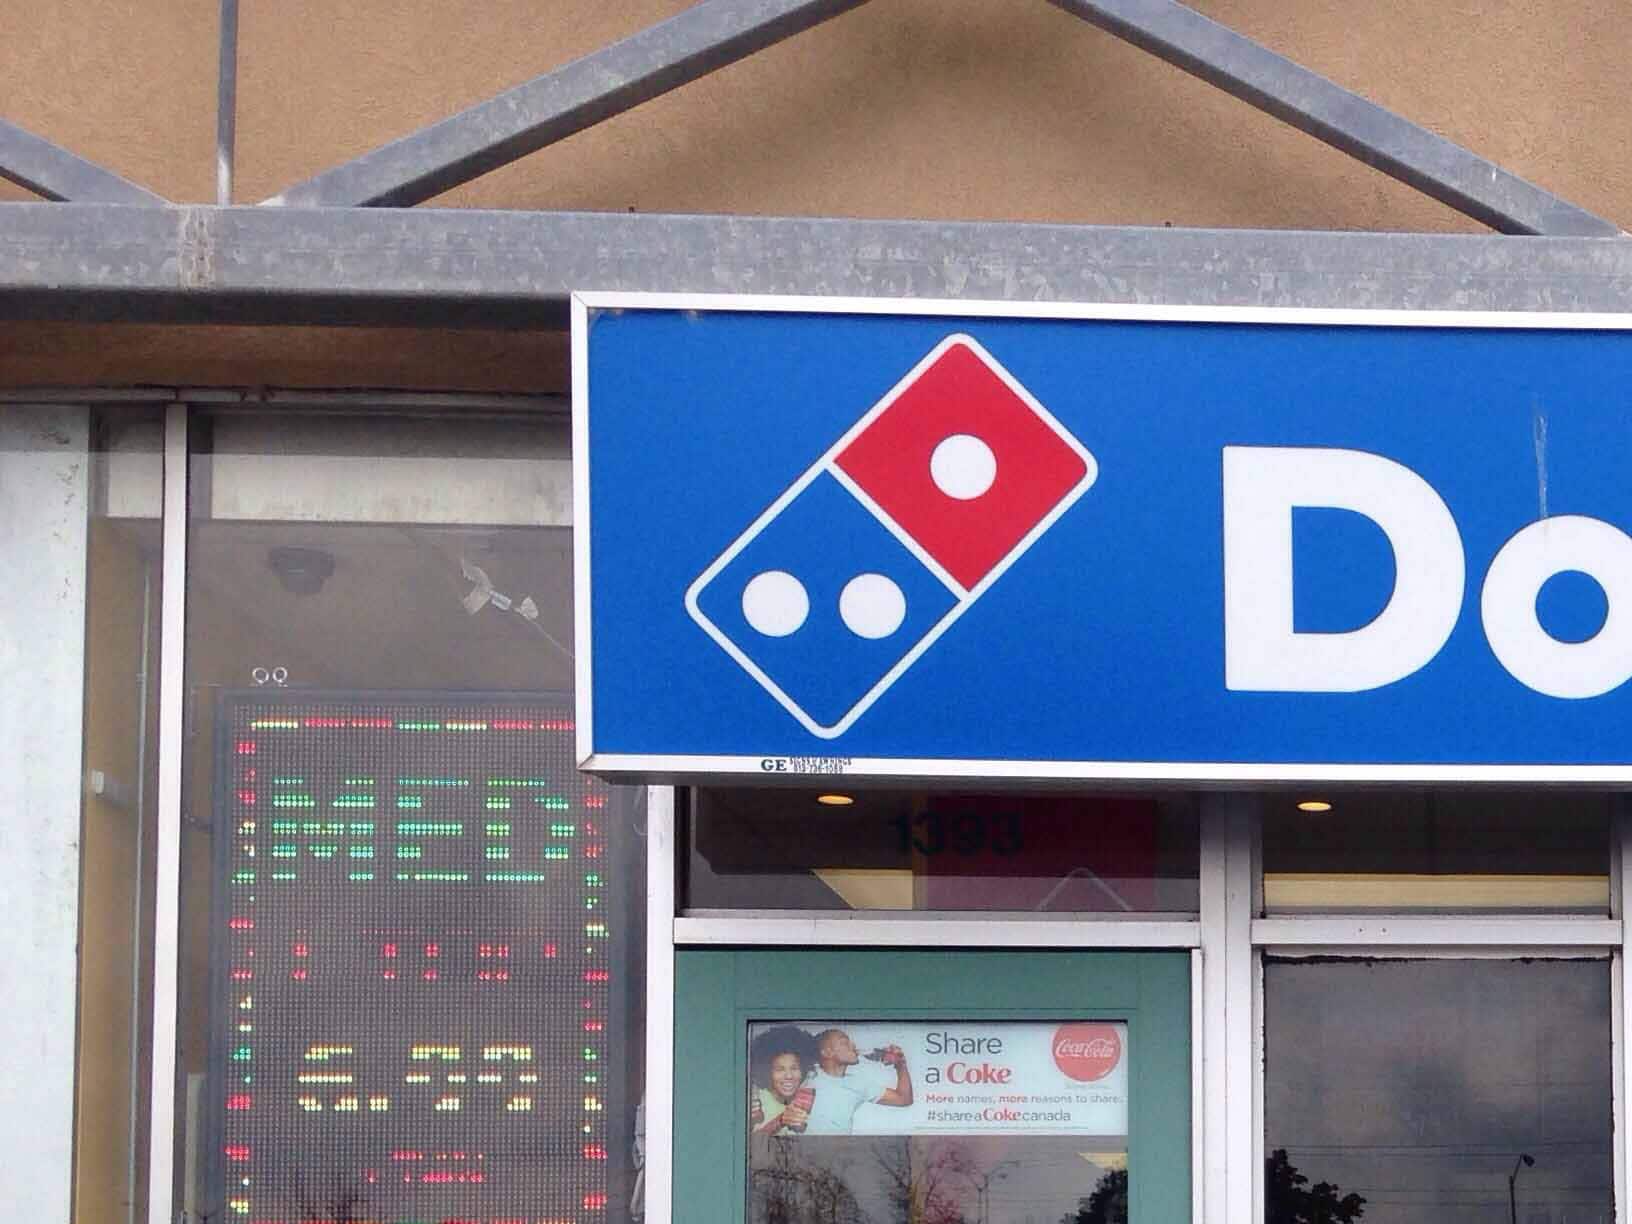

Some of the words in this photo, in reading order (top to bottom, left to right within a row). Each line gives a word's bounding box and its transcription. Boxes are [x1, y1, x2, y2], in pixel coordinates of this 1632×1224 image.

[926, 1031, 1003, 1055] Share
[925, 1067, 940, 1084] a
[947, 1062, 1011, 1085] Coke
[925, 1095, 953, 1103] More
[1000, 1095, 1026, 1103] more
[1075, 1094, 1087, 1103] to
